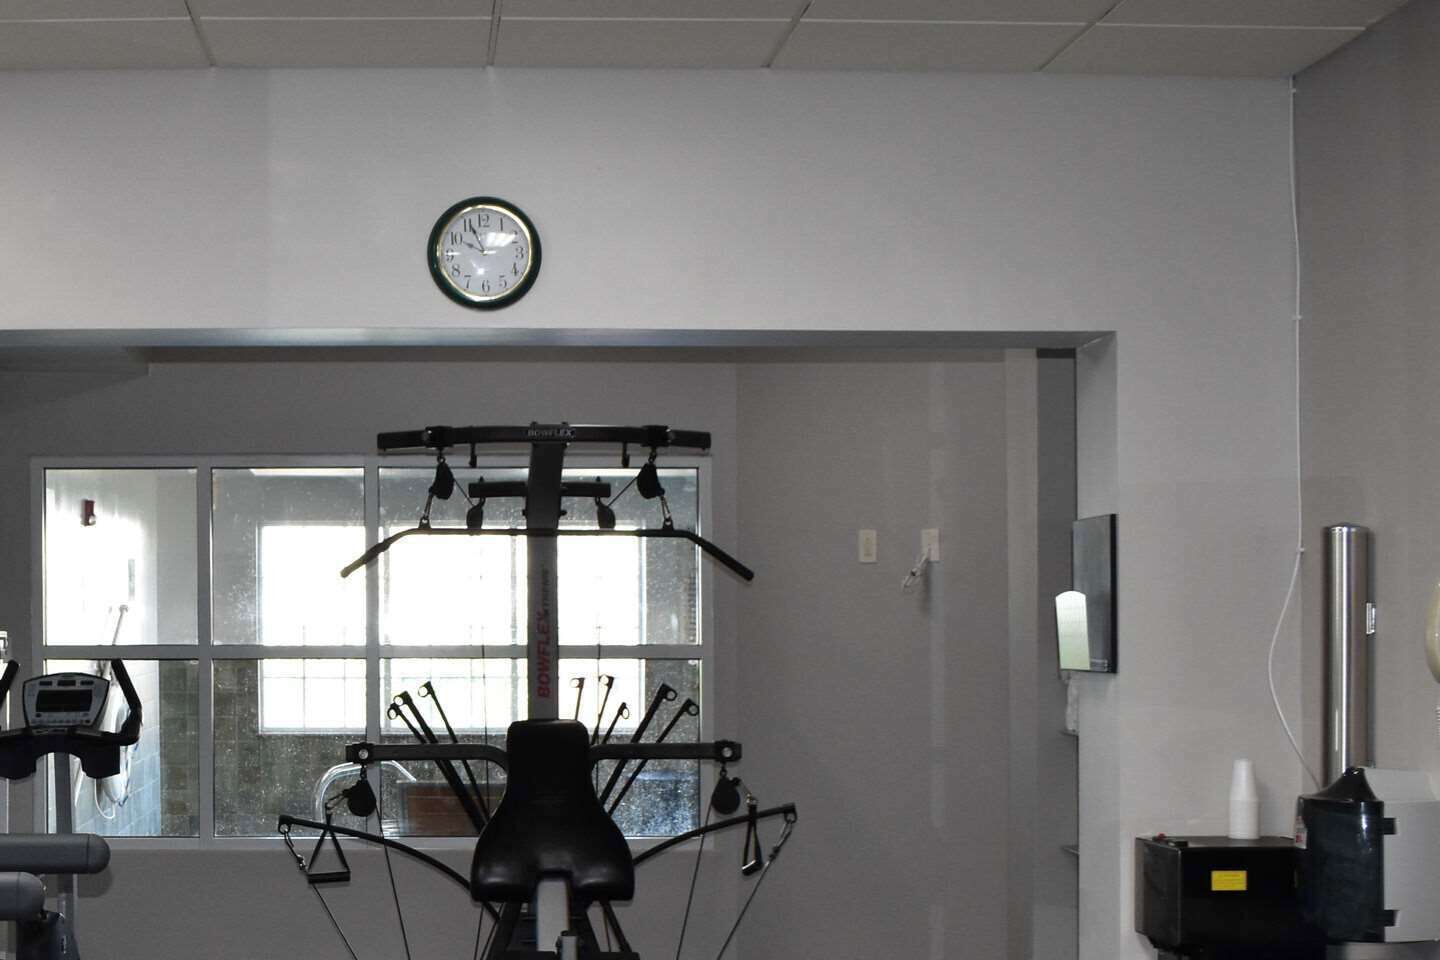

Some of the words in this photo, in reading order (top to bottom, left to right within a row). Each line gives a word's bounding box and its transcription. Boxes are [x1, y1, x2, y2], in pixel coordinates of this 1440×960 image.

[478, 214, 490, 228] 12
[451, 232, 463, 245] 10
[515, 247, 525, 260] 3
[452, 264, 461, 276] 8
[512, 262, 520, 276] 4
[464, 274, 472, 289] 7
[482, 279, 490, 293] 6
[537, 611, 551, 698] BOWFLEX
